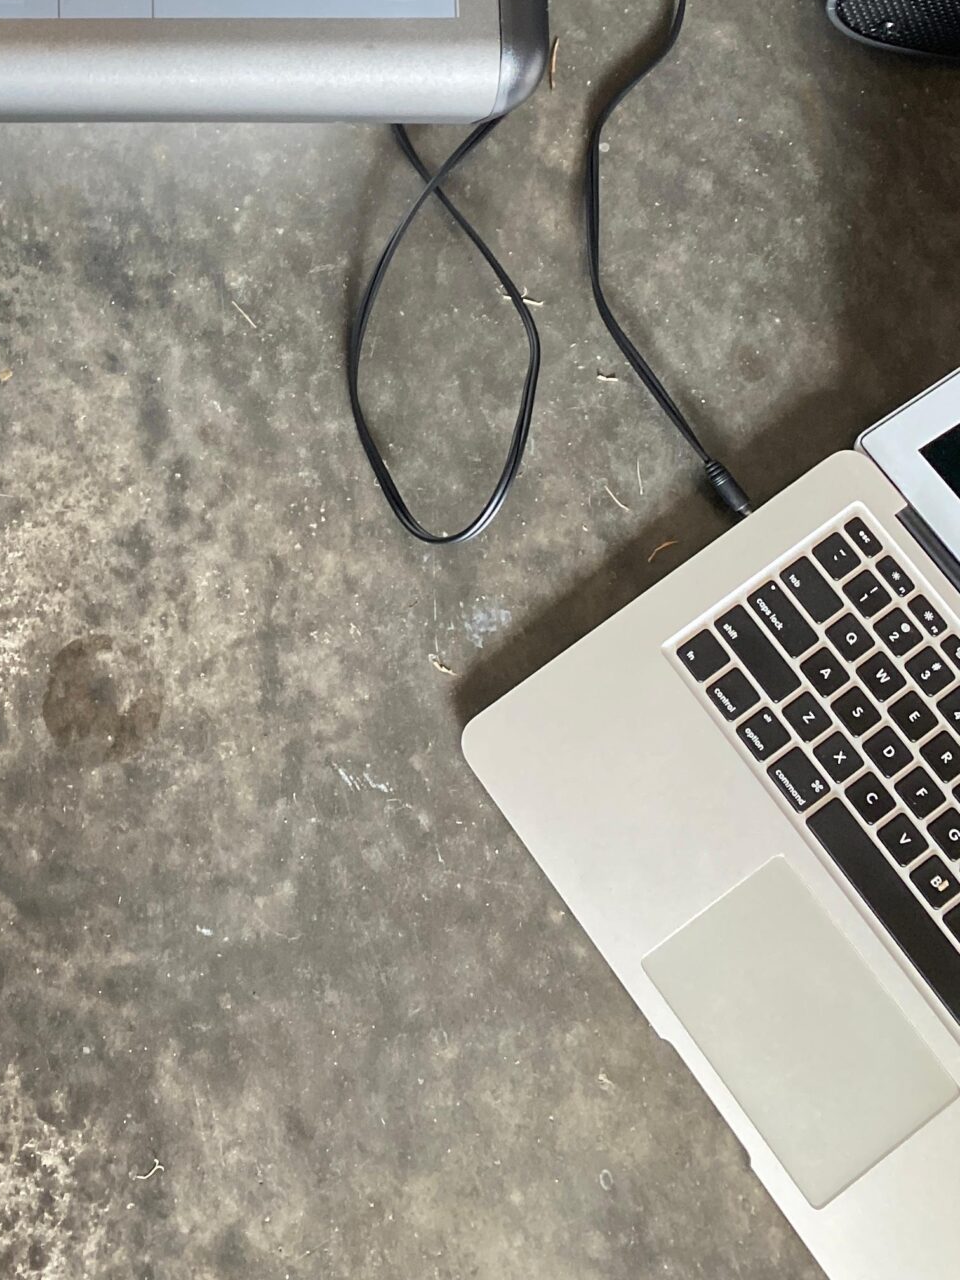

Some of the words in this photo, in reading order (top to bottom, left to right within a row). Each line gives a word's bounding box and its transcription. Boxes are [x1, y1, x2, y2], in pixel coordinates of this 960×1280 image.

[858, 529, 871, 544] esc
[788, 573, 801, 589] tab
[756, 597, 772, 618] caps
[769, 613, 784, 631] lock
[722, 622, 739, 641] shift
[845, 631, 858, 645] Q
[888, 631, 900, 643] 2
[819, 667, 831, 679] A
[875, 668, 891, 684] W
[713, 686, 737, 714] control
[802, 711, 816, 725] Z
[852, 706, 864, 719] S
[908, 710, 921, 723] E
[744, 726, 765, 752] option
[832, 750, 847, 764] X
[882, 745, 896, 759] D
[940, 750, 953, 764] R
[774, 768, 807, 806] command
[915, 786, 929, 799] F
[866, 791, 879, 805] C
[898, 831, 912, 847] V
